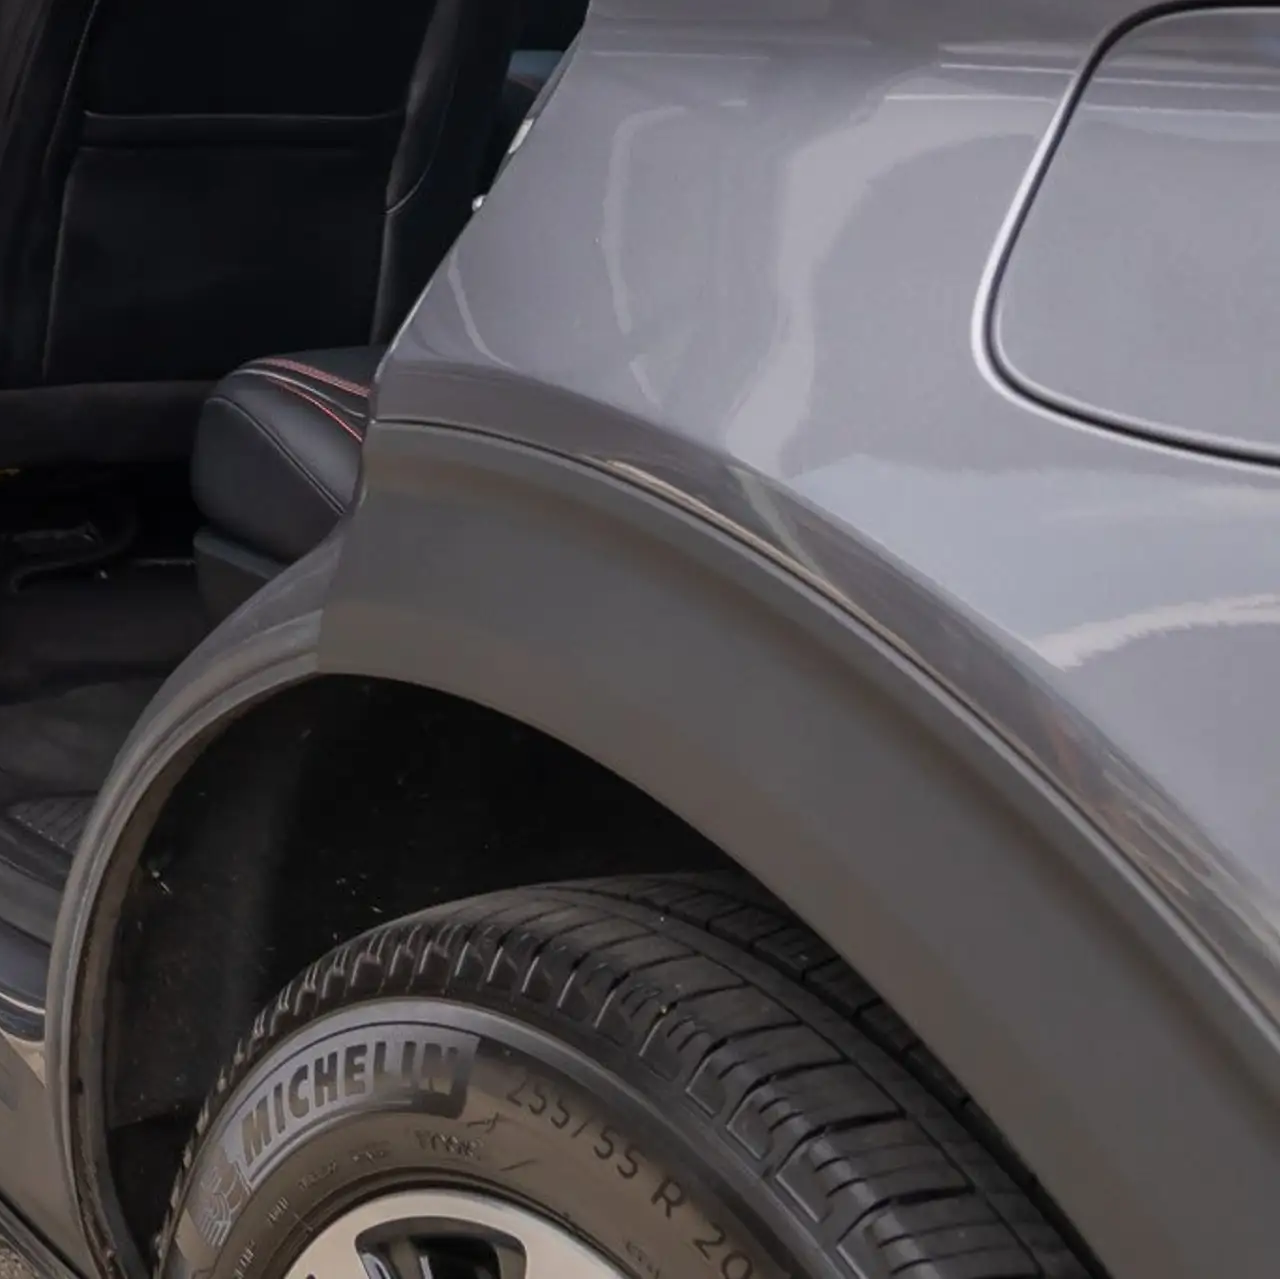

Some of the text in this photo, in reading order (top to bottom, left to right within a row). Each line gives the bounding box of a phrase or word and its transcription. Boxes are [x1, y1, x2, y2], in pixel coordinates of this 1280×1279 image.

[240, 1040, 460, 1168] MICHELIN
[506, 1076, 648, 1180] 255/55
[650, 1176, 687, 1220] R
